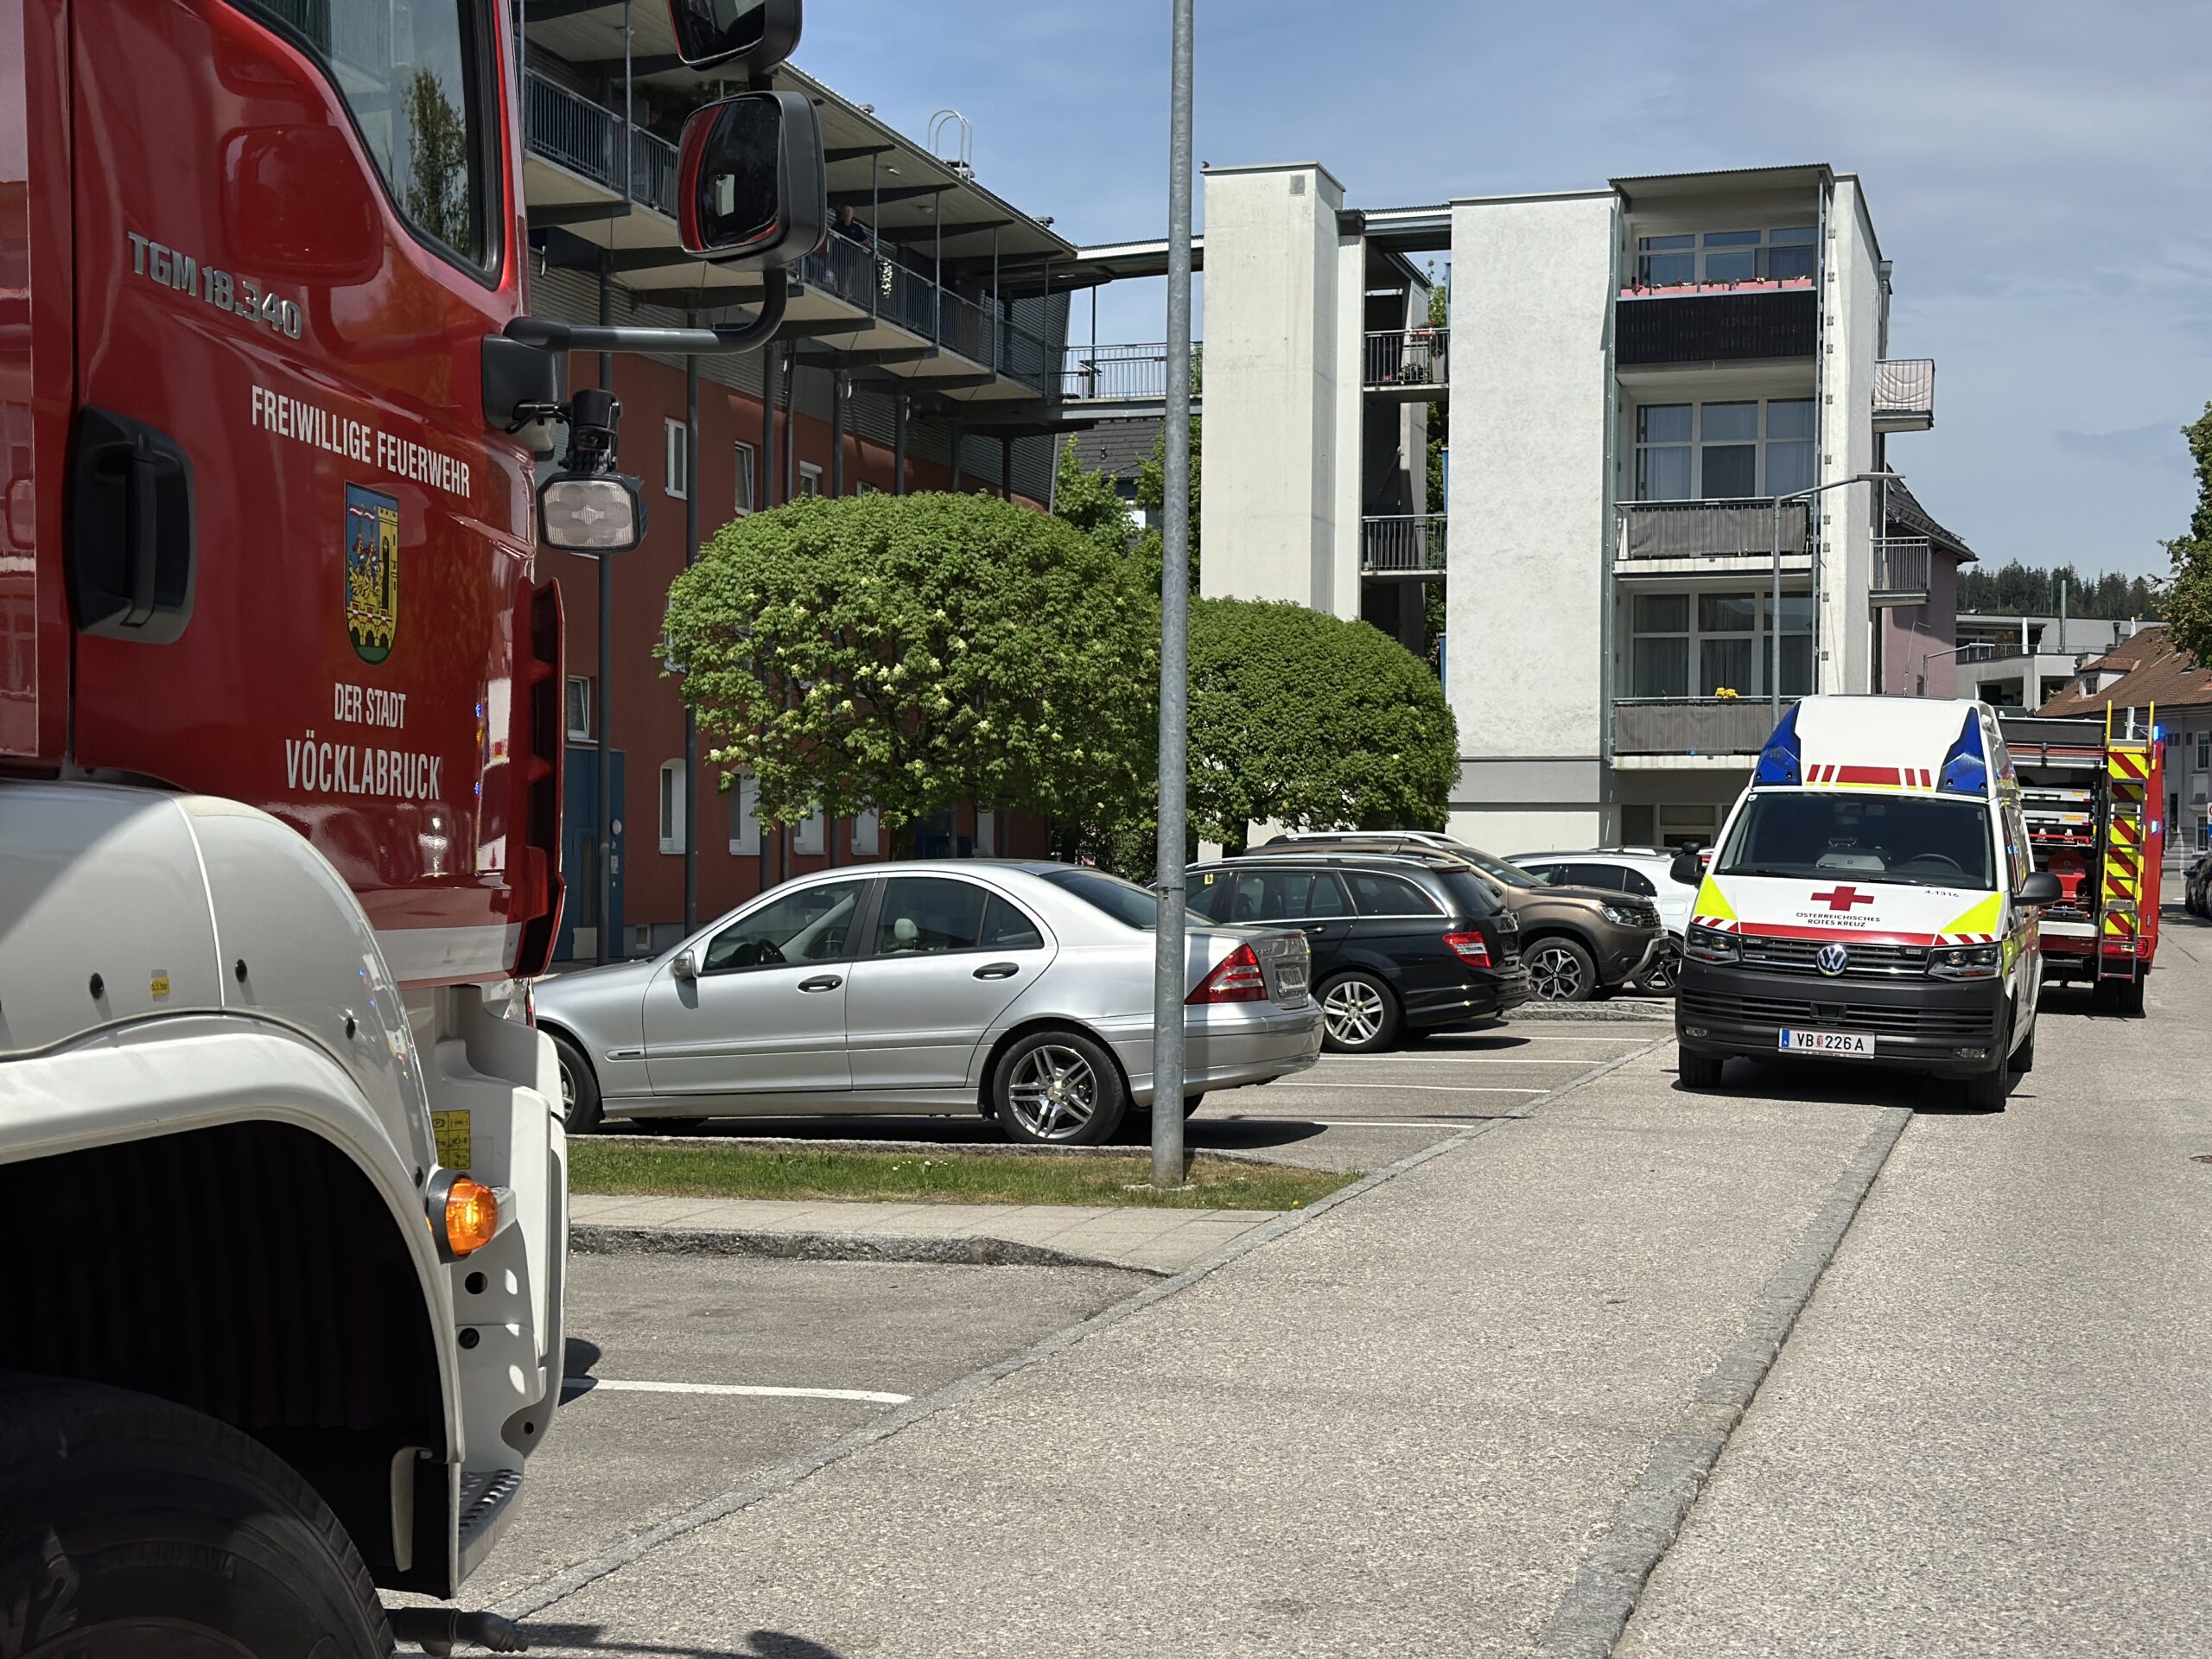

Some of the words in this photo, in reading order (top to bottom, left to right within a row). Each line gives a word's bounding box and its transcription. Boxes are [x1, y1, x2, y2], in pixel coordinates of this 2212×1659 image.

[128, 231, 197, 297] TGM
[201, 265, 302, 340] 18.340
[251, 385, 372, 464] FREIWILLIGE
[377, 430, 470, 498] FEUERWEHR
[334, 682, 362, 723] DER
[366, 688, 406, 729] STADT
[285, 729, 441, 800] VÖCKLABRUCK
[1808, 918, 1835, 927] ROTES
[1797, 1033, 1814, 1047] VB
[1825, 1035, 1851, 1050] 226
[1854, 1037, 1864, 1052] A
